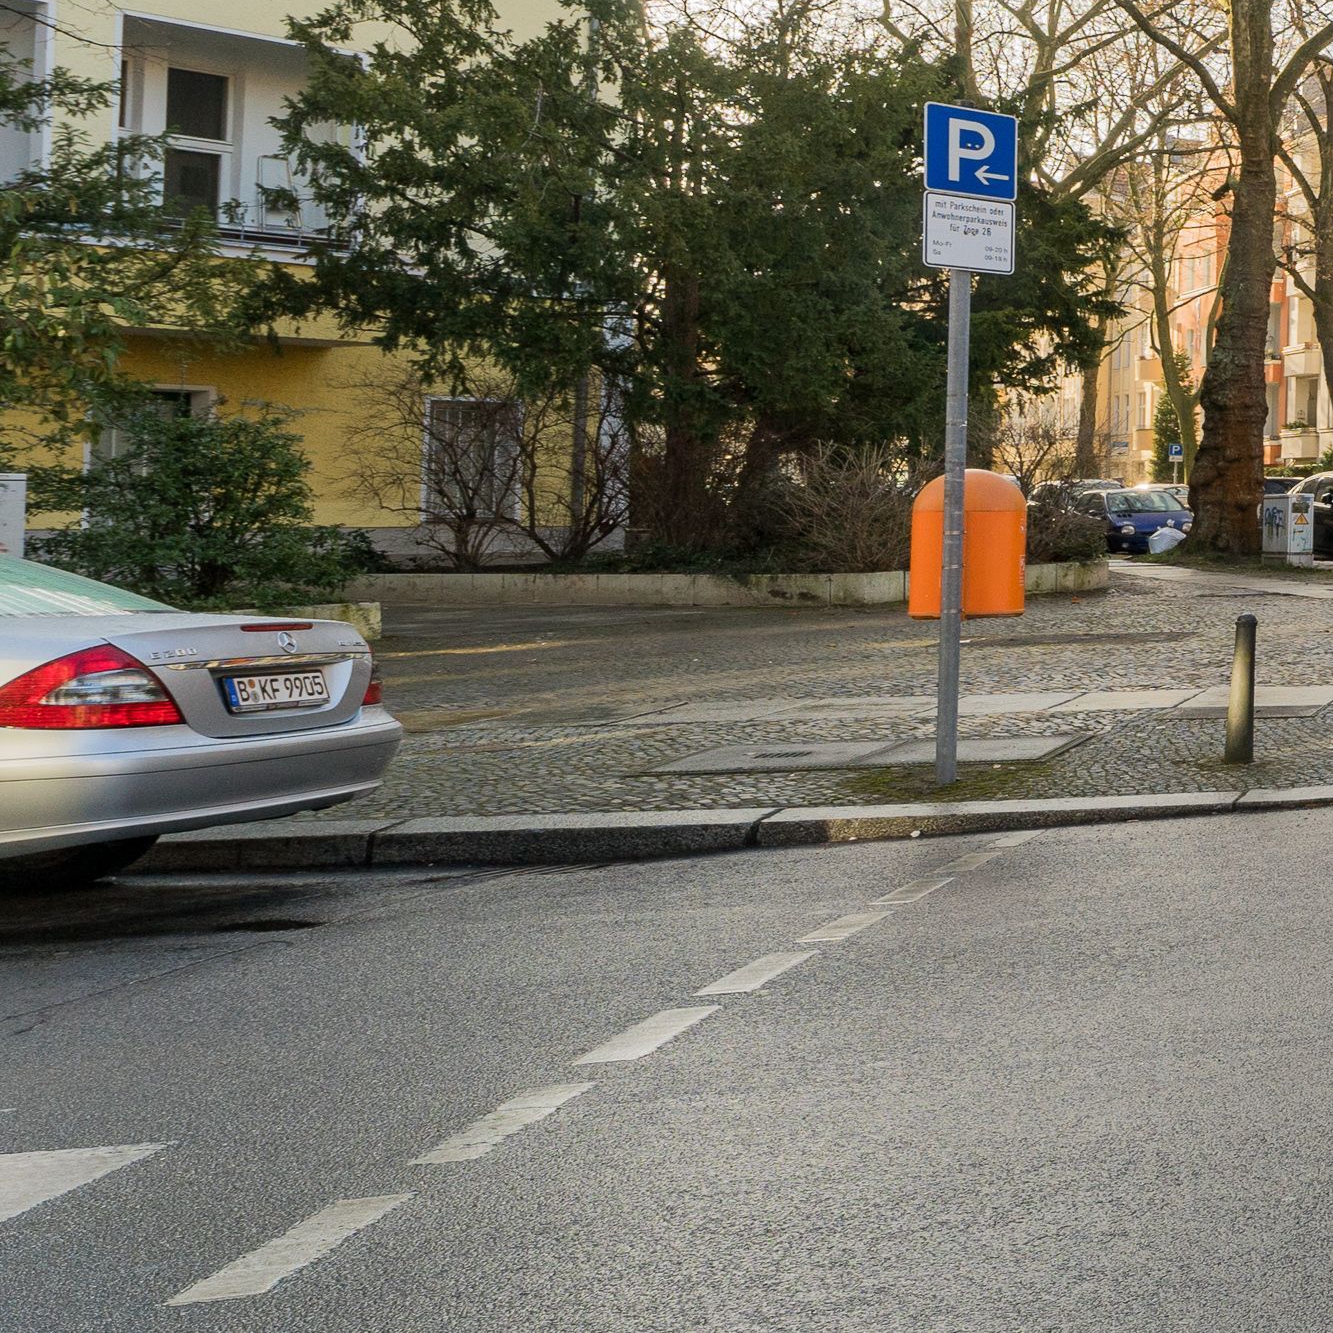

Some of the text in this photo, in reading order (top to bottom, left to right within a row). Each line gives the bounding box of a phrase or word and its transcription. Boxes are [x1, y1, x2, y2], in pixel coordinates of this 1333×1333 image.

[948, 117, 996, 182] P
[934, 200, 1004, 216] mit Parkschein oder
[931, 210, 1008, 228] Anwohnerparkausweis
[949, 222, 960, 233] für
[1172, 445, 1181, 455] P
[237, 674, 324, 702] B KF 9905
